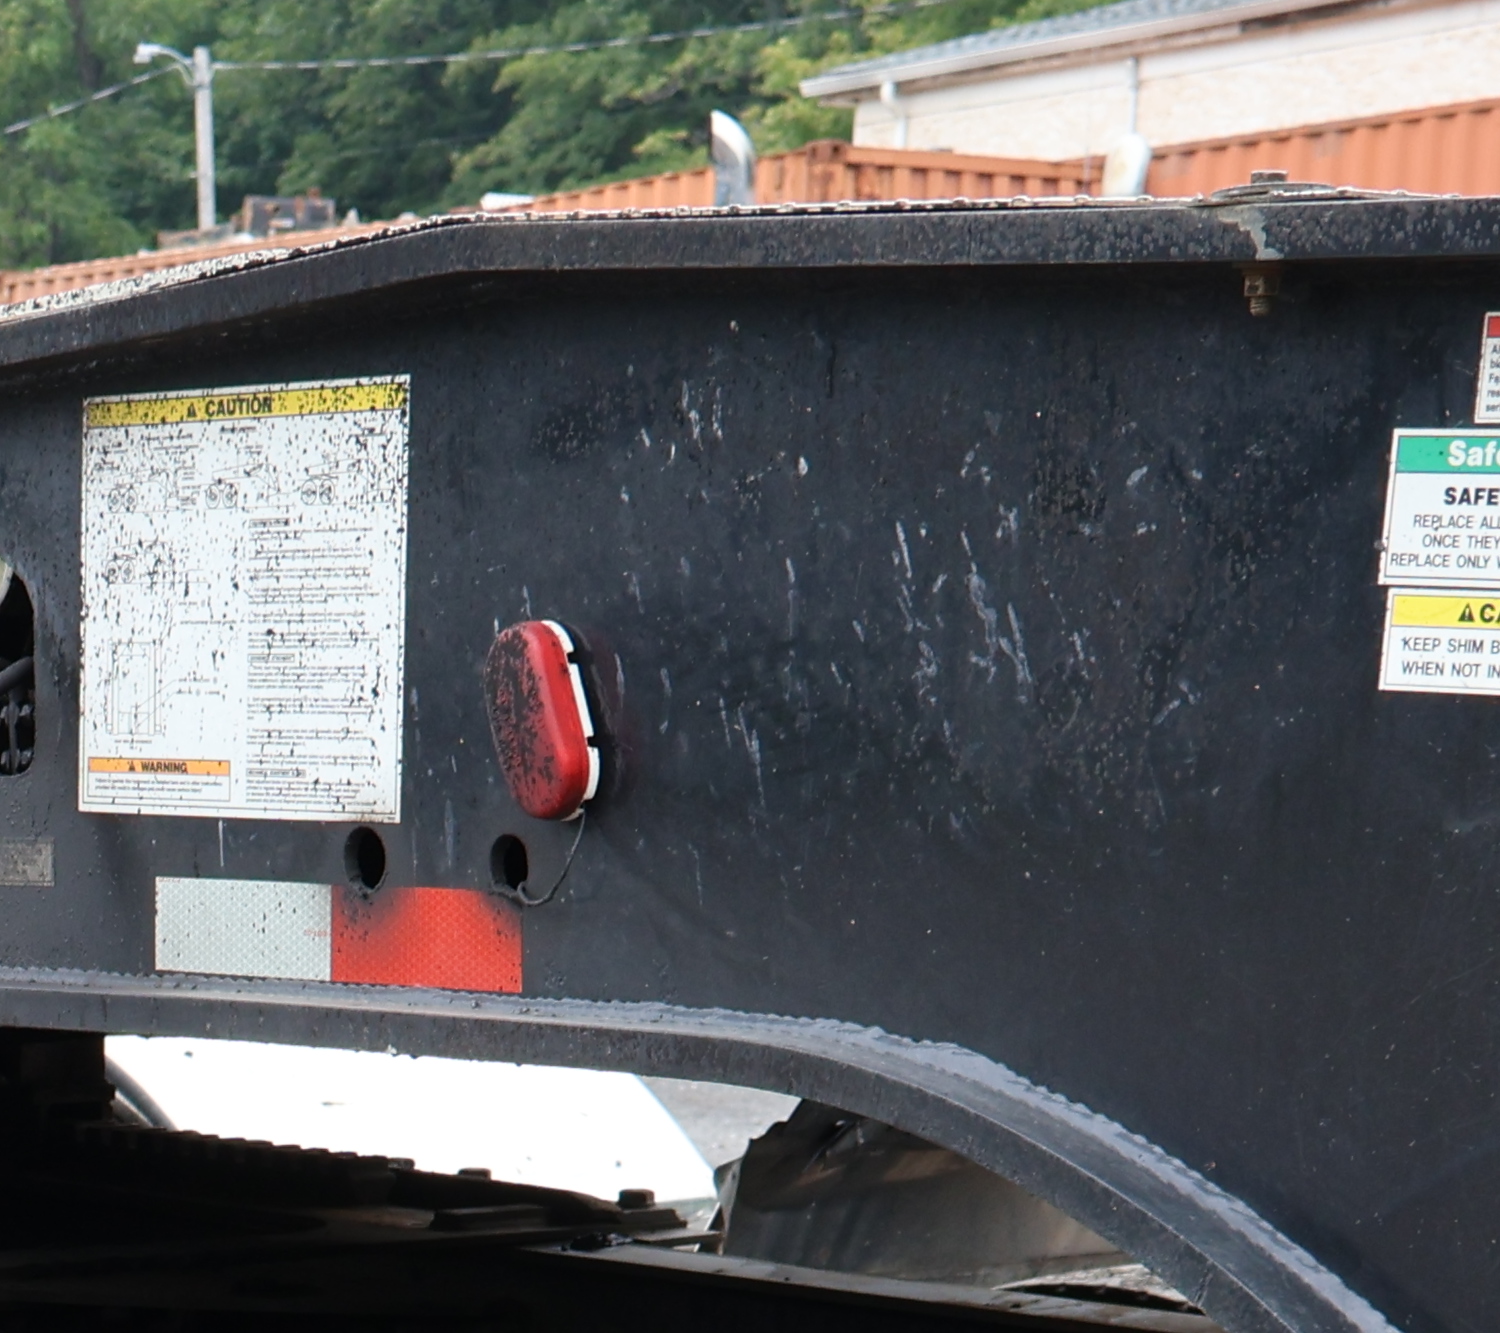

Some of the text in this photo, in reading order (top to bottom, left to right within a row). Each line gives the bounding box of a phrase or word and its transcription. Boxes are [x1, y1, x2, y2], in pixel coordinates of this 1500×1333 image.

[205, 396, 272, 416] CAUTION
[1414, 515, 1474, 530] REPLACE
[1422, 535, 1460, 549] ONCE
[1390, 555, 1450, 569] REPLACE
[1456, 556, 1490, 569] ONLY
[1402, 637, 1440, 652] KEEP
[1447, 639, 1484, 654] SHIM
[1401, 661, 1445, 676] WHEN
[1451, 663, 1480, 678] NOT
[1488, 664, 1500, 678] IN
[141, 761, 188, 773] WARNING
